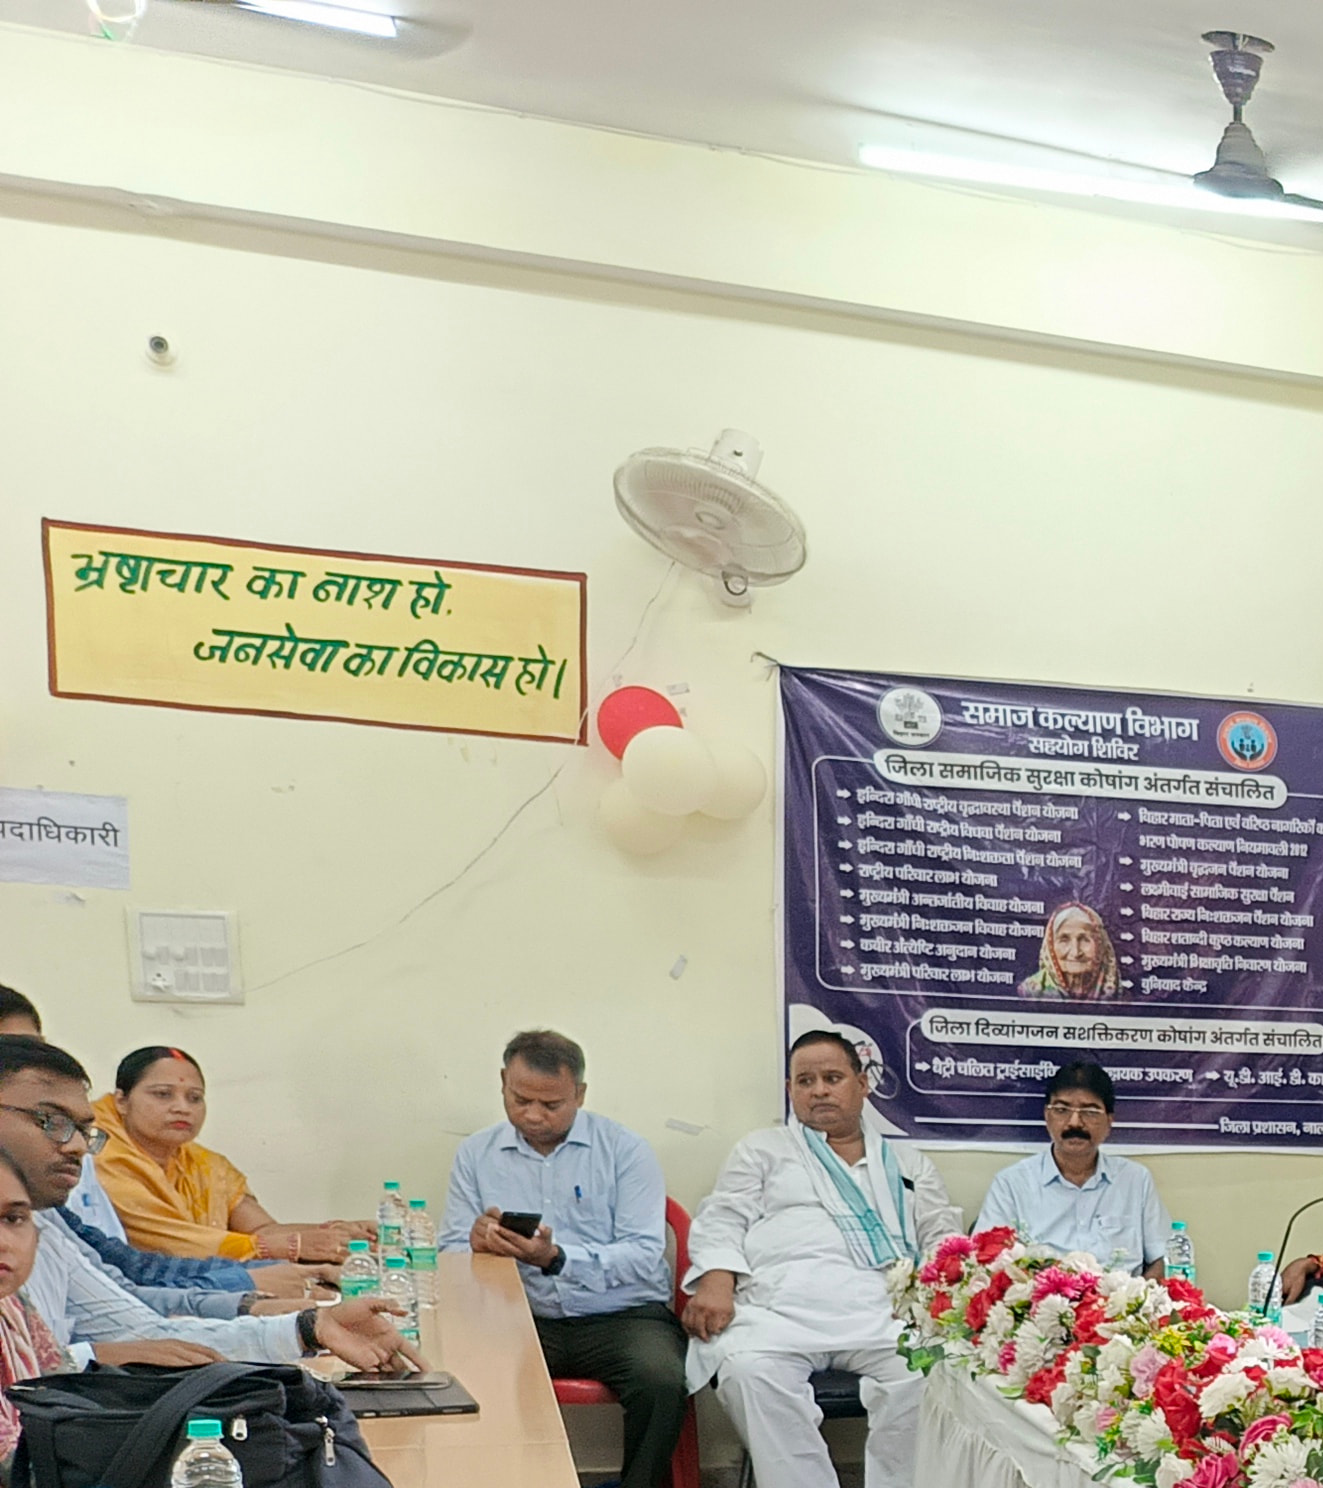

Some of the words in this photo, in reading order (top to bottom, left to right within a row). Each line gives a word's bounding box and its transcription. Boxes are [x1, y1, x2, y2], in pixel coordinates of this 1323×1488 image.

[246, 566, 307, 599] का
[313, 571, 403, 610] नाश
[194, 622, 350, 672] जनसेवा
[343, 643, 400, 677] का
[397, 639, 514, 690] विकास
[961, 701, 1036, 730] समाज
[1039, 705, 1122, 736] कल्याण
[1126, 707, 1199, 741] विभाग
[1028, 735, 1089, 757] सहयोग
[1092, 736, 1139, 761] शिविर
[885, 755, 935, 778] जिला
[1024, 767, 1075, 791] सुरक्षा
[1079, 767, 1139, 791] कोषांग
[1143, 773, 1200, 796] अंतर्गत
[1204, 776, 1275, 801] संचालित
[929, 1015, 972, 1036] जिला
[975, 1017, 1060, 1040] दिव्यांगजन
[1063, 1023, 1153, 1044] सशक्तिकरण
[1157, 1025, 1206, 1045] कोषांग
[1210, 1029, 1259, 1047] अंतर्गत
[1263, 1028, 1323, 1049] संचालित
[1144, 1066, 1194, 1083] उपकरण
[1220, 1117, 1249, 1134] जिला
